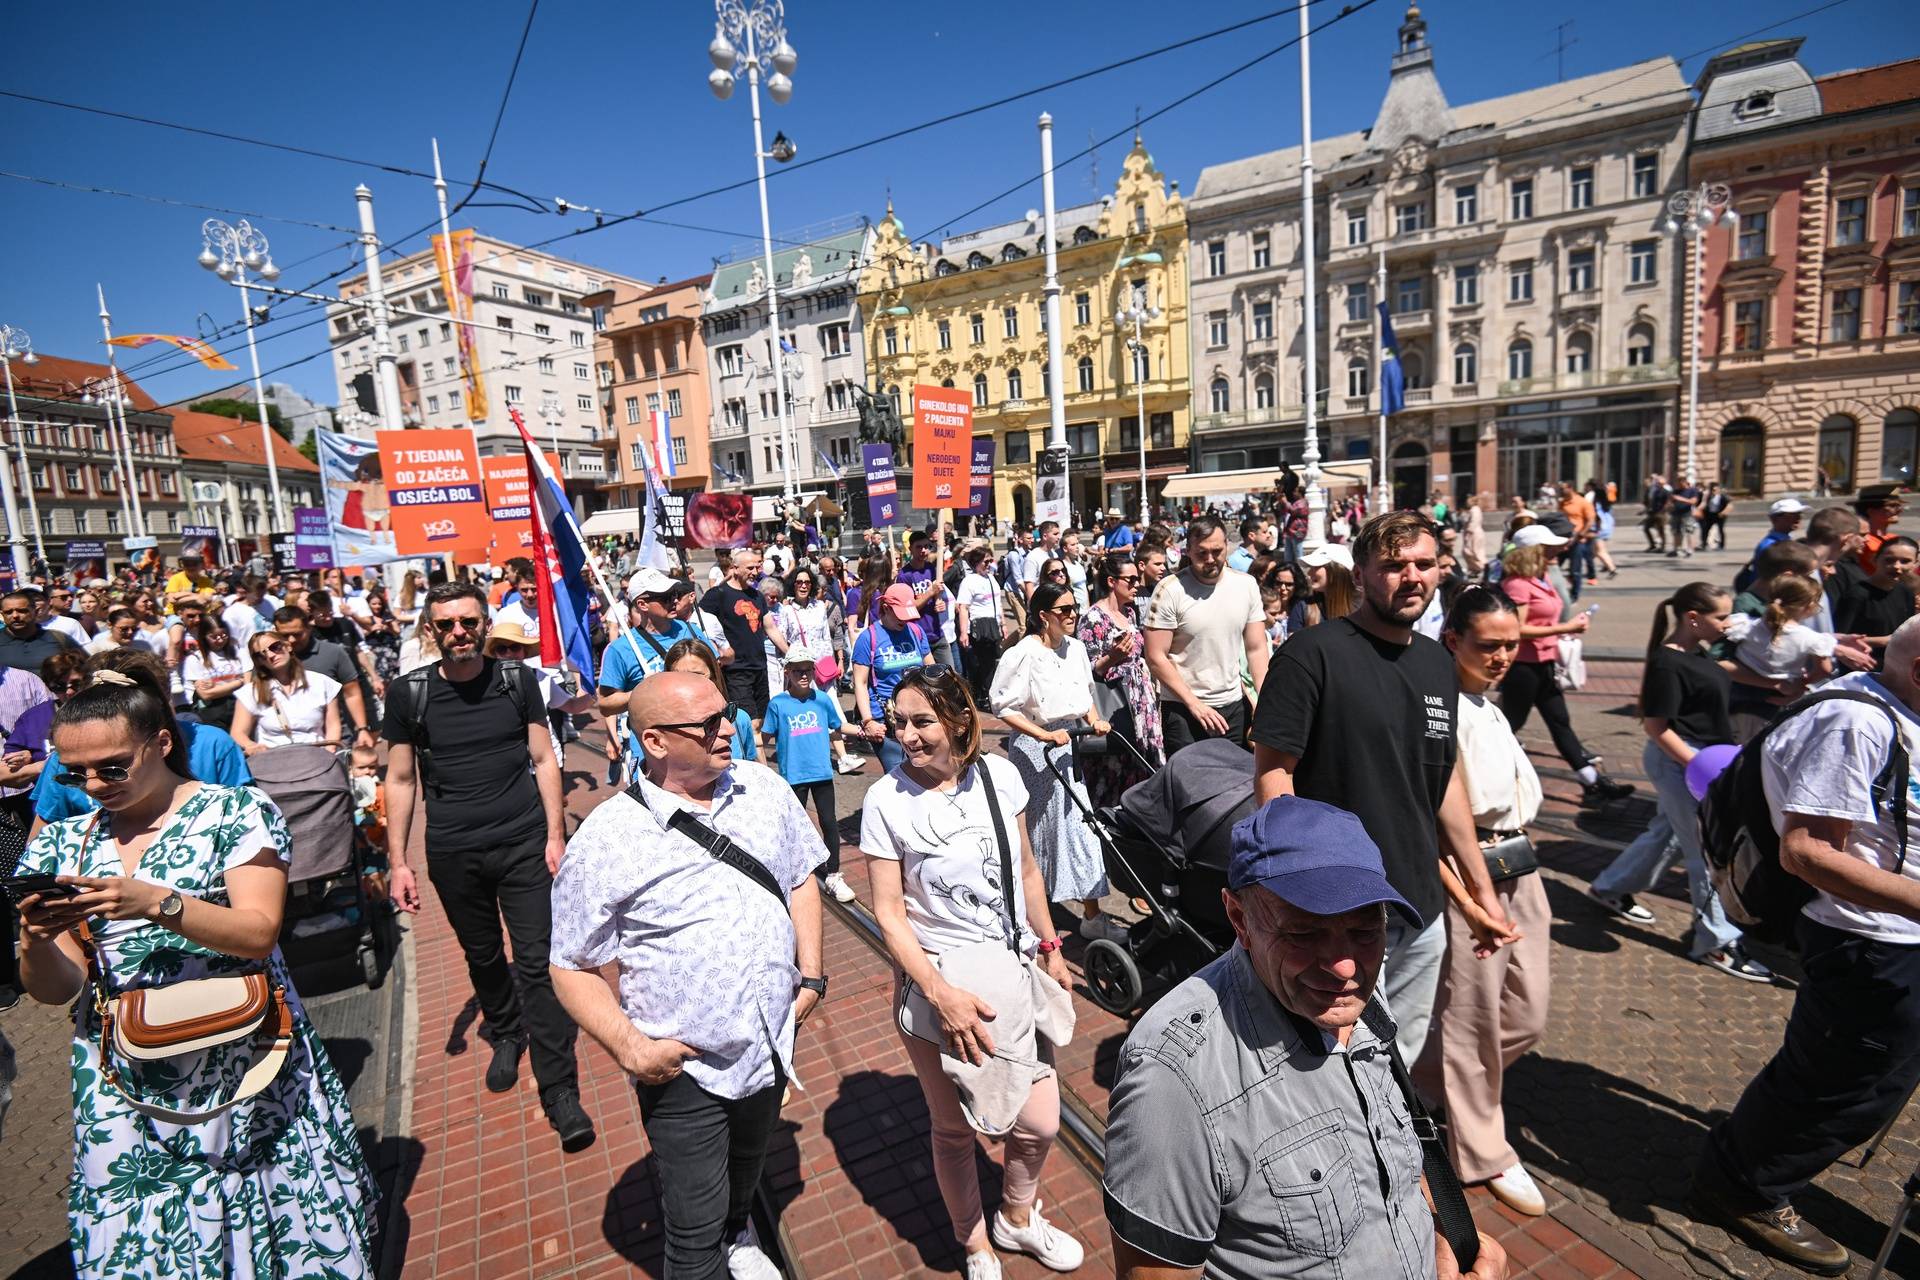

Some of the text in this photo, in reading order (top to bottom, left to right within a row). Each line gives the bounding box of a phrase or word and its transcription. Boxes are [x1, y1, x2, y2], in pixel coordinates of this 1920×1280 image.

[919, 399, 969, 415] GINEKOLOG IMA
[925, 413, 964, 427] 2 PACIJENTA
[934, 428, 955, 439] MAJKU
[393, 449, 464, 464] 7 TJEDANA
[927, 454, 960, 465] NEROĐENO
[395, 466, 469, 485] OD ZAČEĆA
[489, 469, 528, 480] NAJUGRO
[933, 467, 954, 477] DIJETE
[396, 487, 475, 505] OSJEĆA BOL
[507, 494, 530, 504] HRVA
[661, 496, 684, 507] VAKO
[184, 527, 195, 537] ZA
[787, 710, 818, 727] HOD
